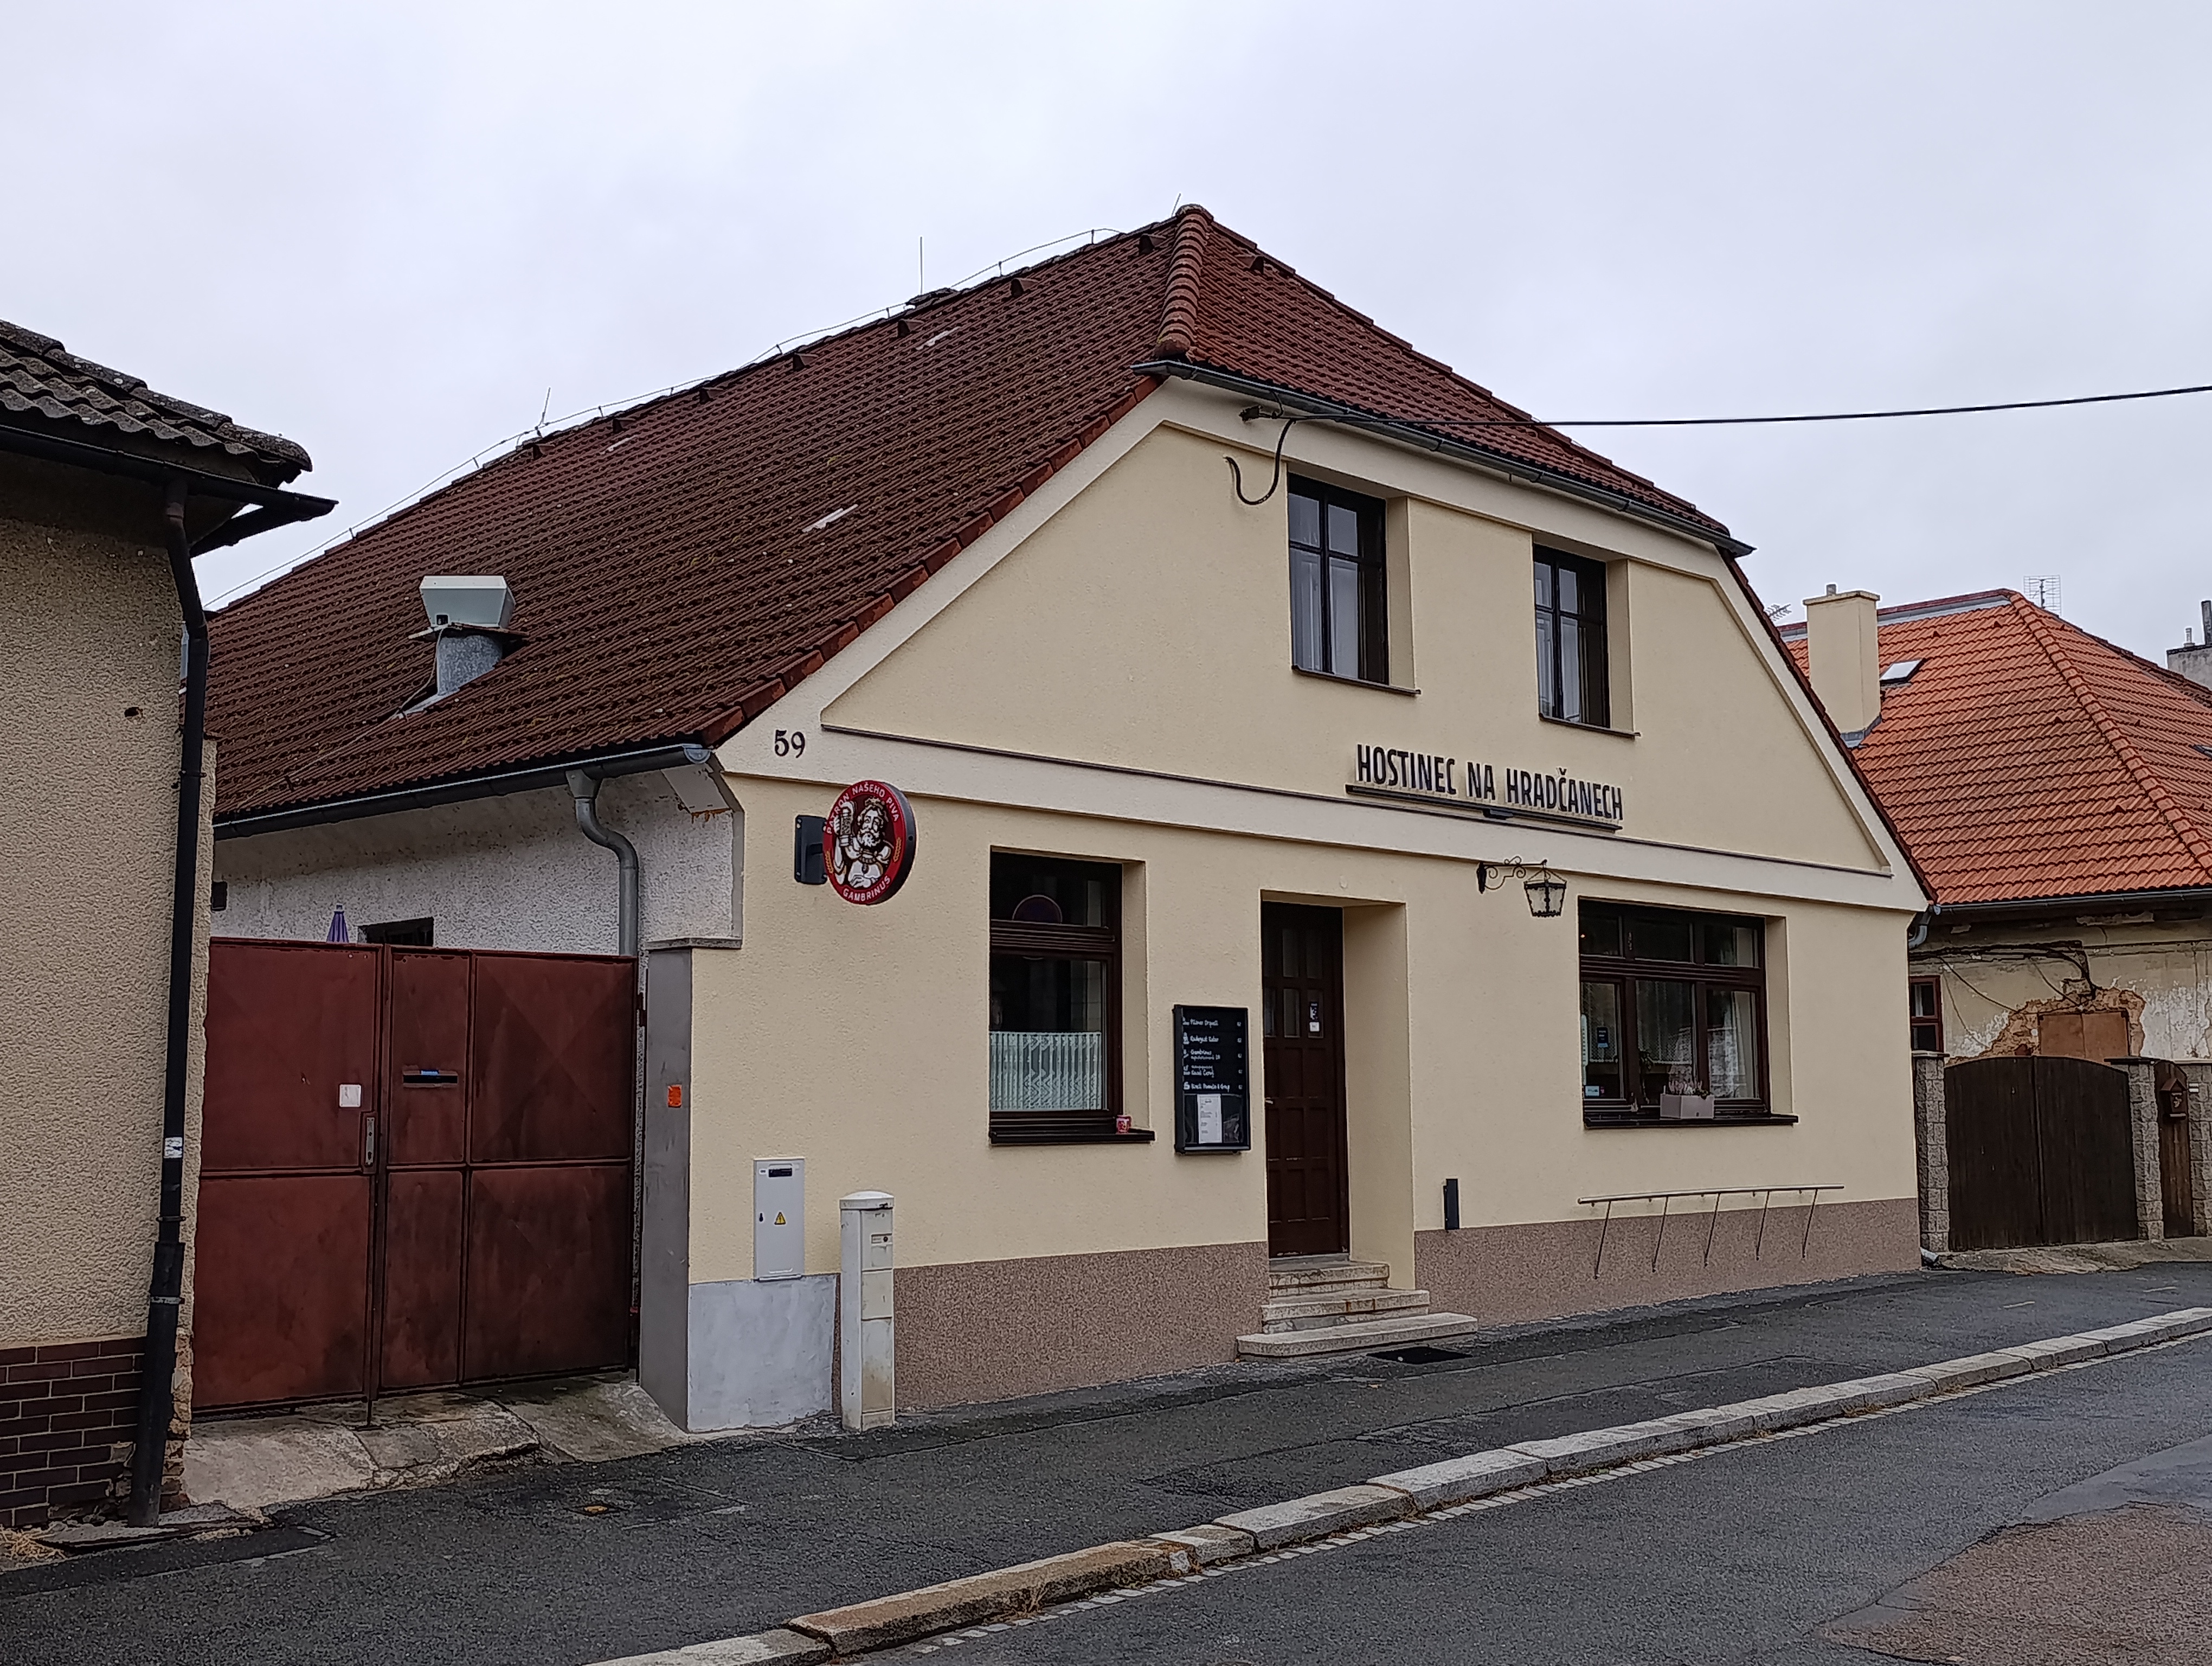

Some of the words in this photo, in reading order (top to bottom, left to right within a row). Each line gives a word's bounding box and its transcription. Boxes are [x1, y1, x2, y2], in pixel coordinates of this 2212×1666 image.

[774, 729, 805, 759] 59
[1357, 744, 1457, 795] HOSTINEC
[1467, 761, 1496, 800] NA
[1506, 767, 1624, 821] HRADČANECH
[826, 793, 850, 834] PATRON
[852, 781, 885, 798] NAŠEHO
[886, 797, 899, 822] PIVA
[843, 875, 891, 902] GAMBRINUS
